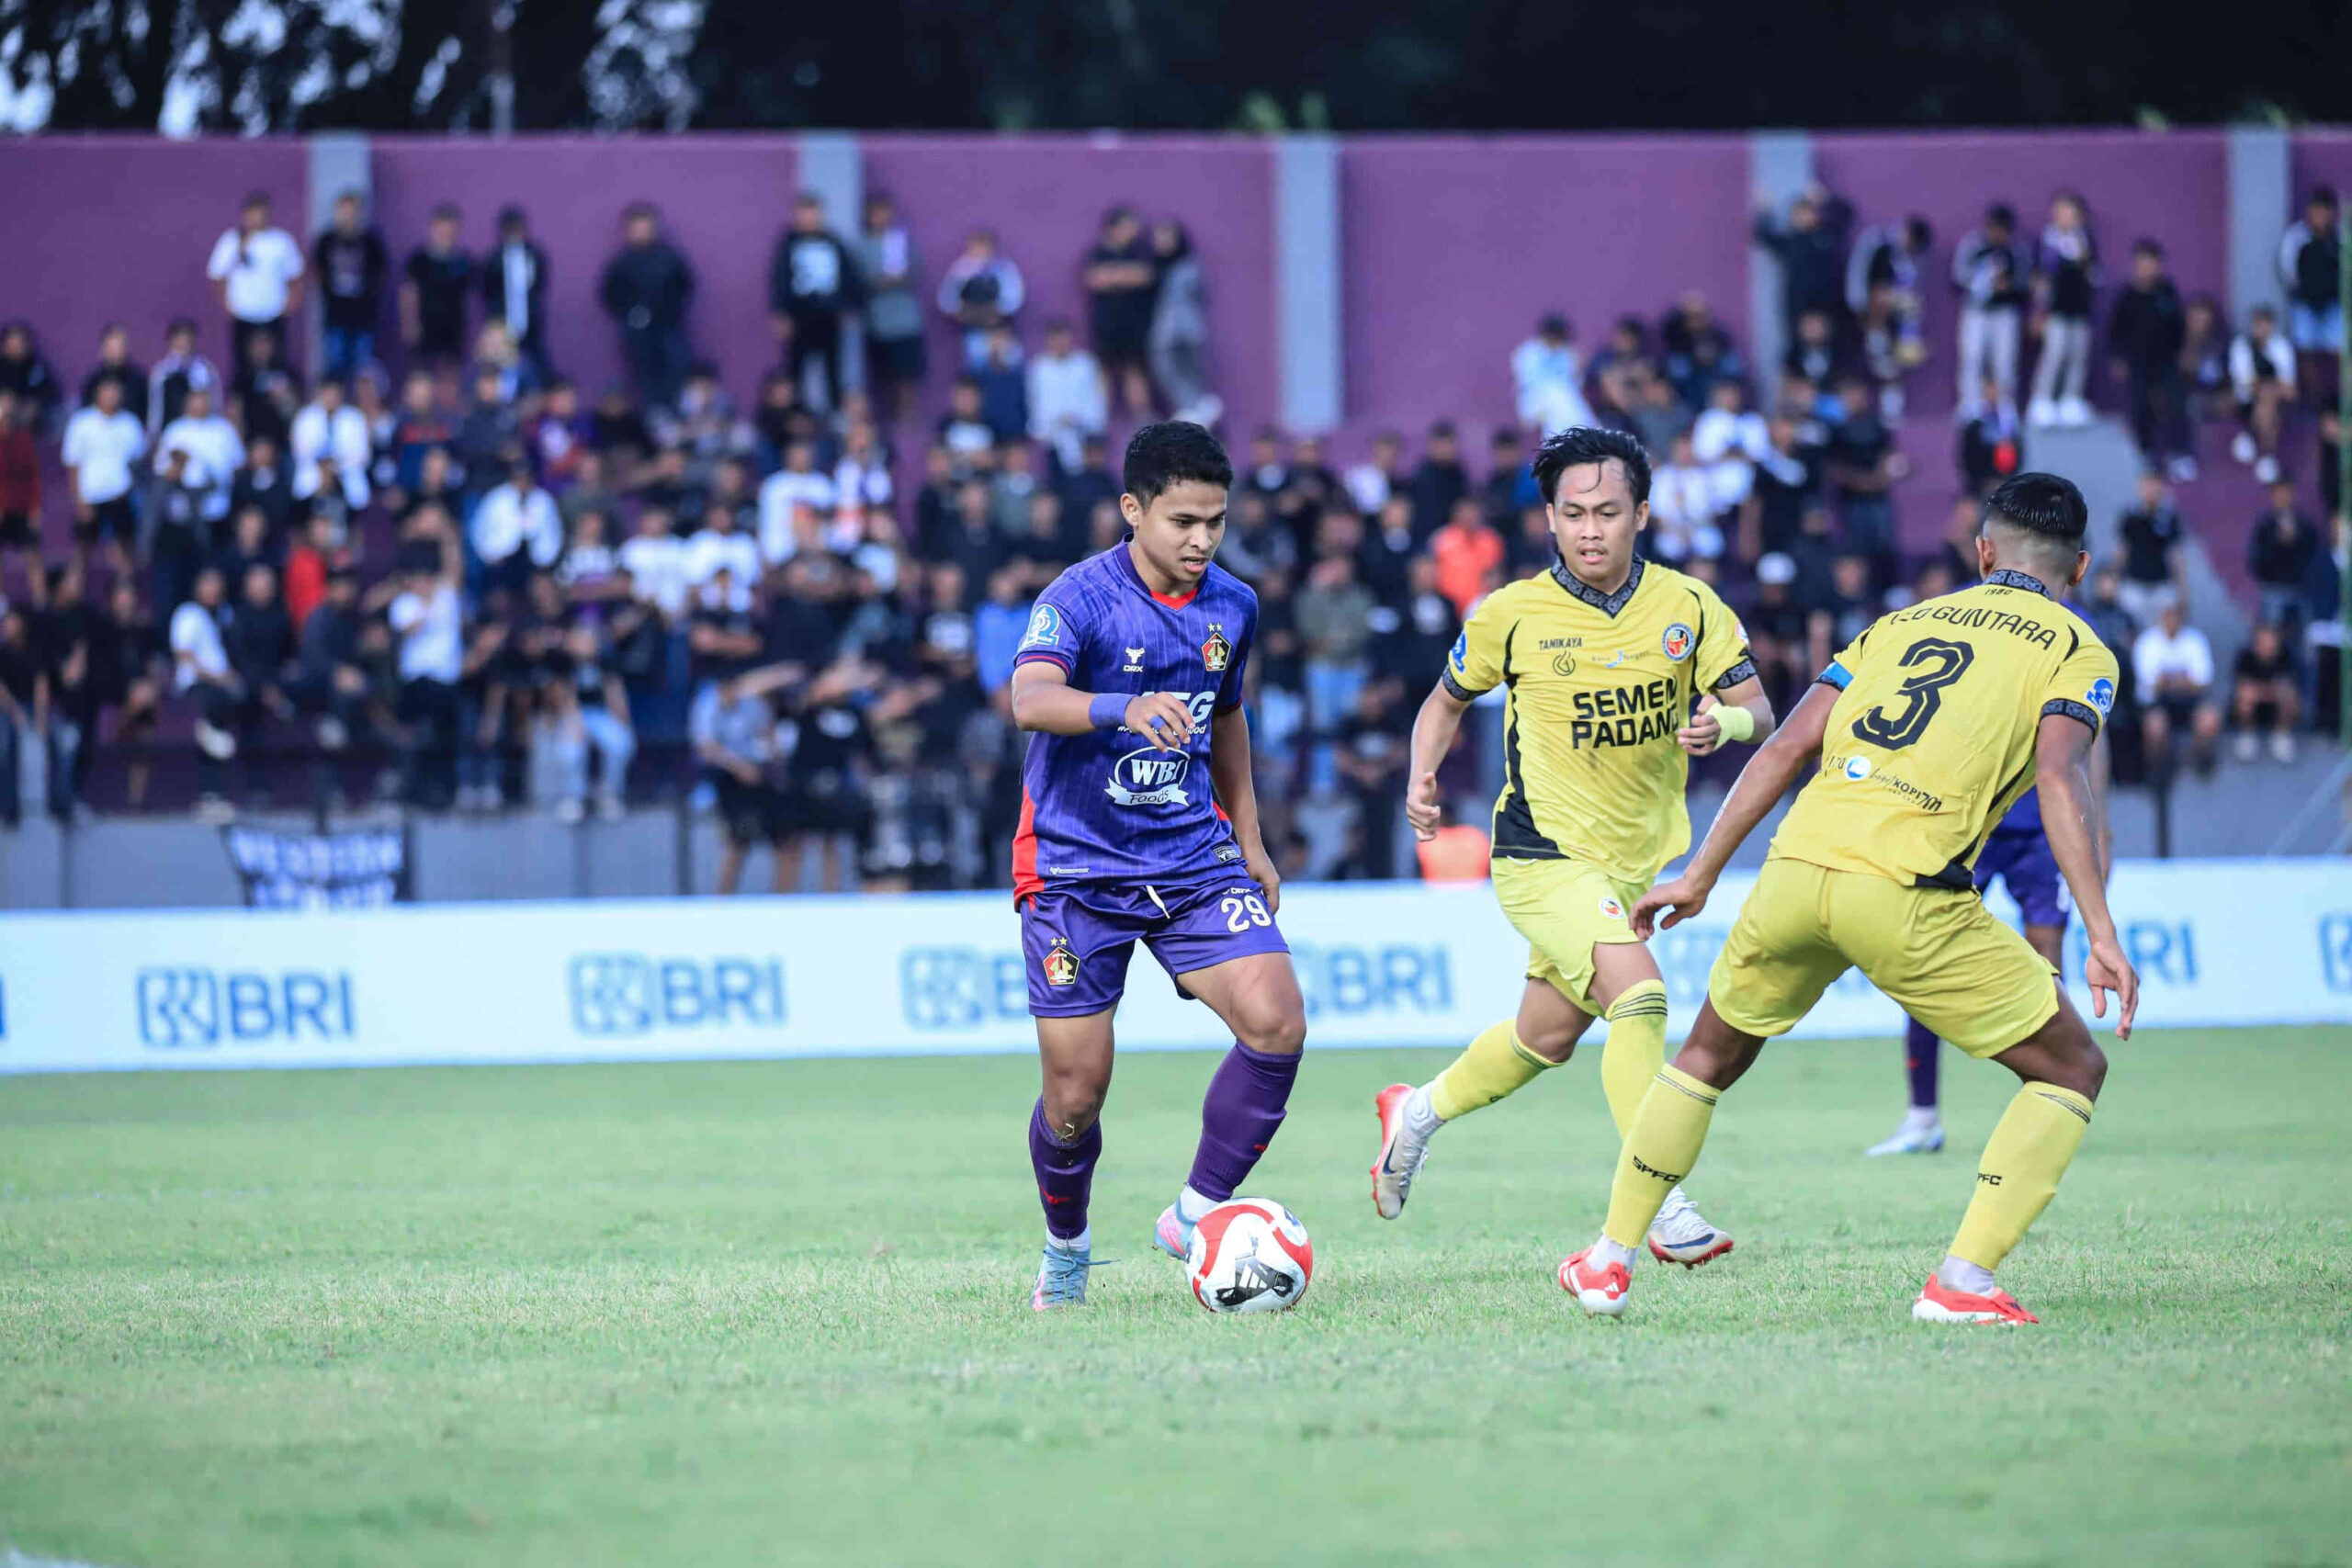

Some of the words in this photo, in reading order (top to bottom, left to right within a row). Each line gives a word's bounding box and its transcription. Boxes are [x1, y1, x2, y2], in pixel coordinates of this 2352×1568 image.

[1539, 637, 1583, 650] TANIKAYA
[1932, 605, 2057, 650] GUNTARA
[1573, 677, 1678, 719] SEMEN
[1851, 637, 1974, 751] 3
[1220, 895, 1272, 932] 29
[660, 955, 786, 1027] BRI
[1329, 942, 1454, 1014] BRI
[229, 972, 354, 1041] BRI
[1632, 1155, 1680, 1182] SPFC
